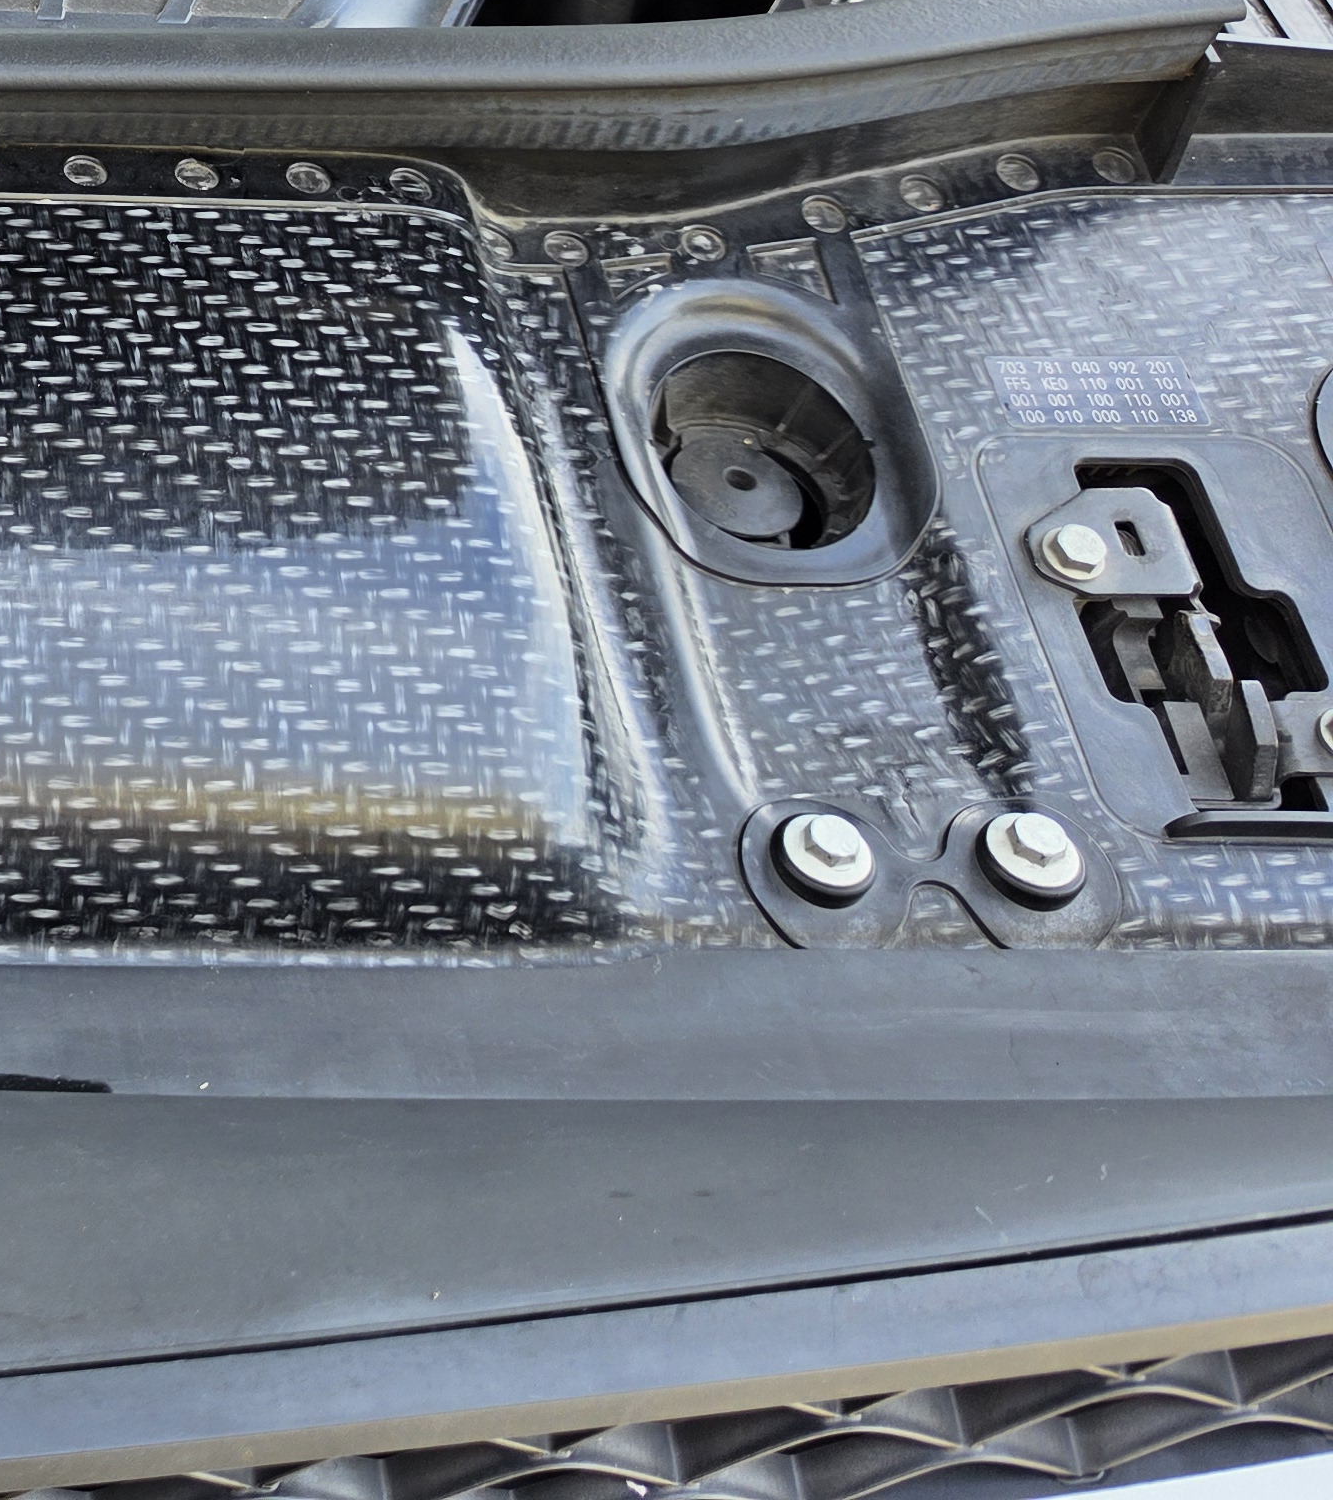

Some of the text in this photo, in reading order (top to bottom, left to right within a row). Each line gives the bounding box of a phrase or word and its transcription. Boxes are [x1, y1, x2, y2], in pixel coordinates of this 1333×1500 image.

[996, 361, 1174, 375] 703 781 040 992 201
[1004, 377, 1031, 391] FF5
[1079, 377, 1107, 391] 110
[1115, 377, 1144, 391] 001
[1154, 377, 1182, 391] 101
[1009, 393, 1190, 407] 001 001 100 110 001
[1017, 409, 1198, 423] 100 010 000 110 138
